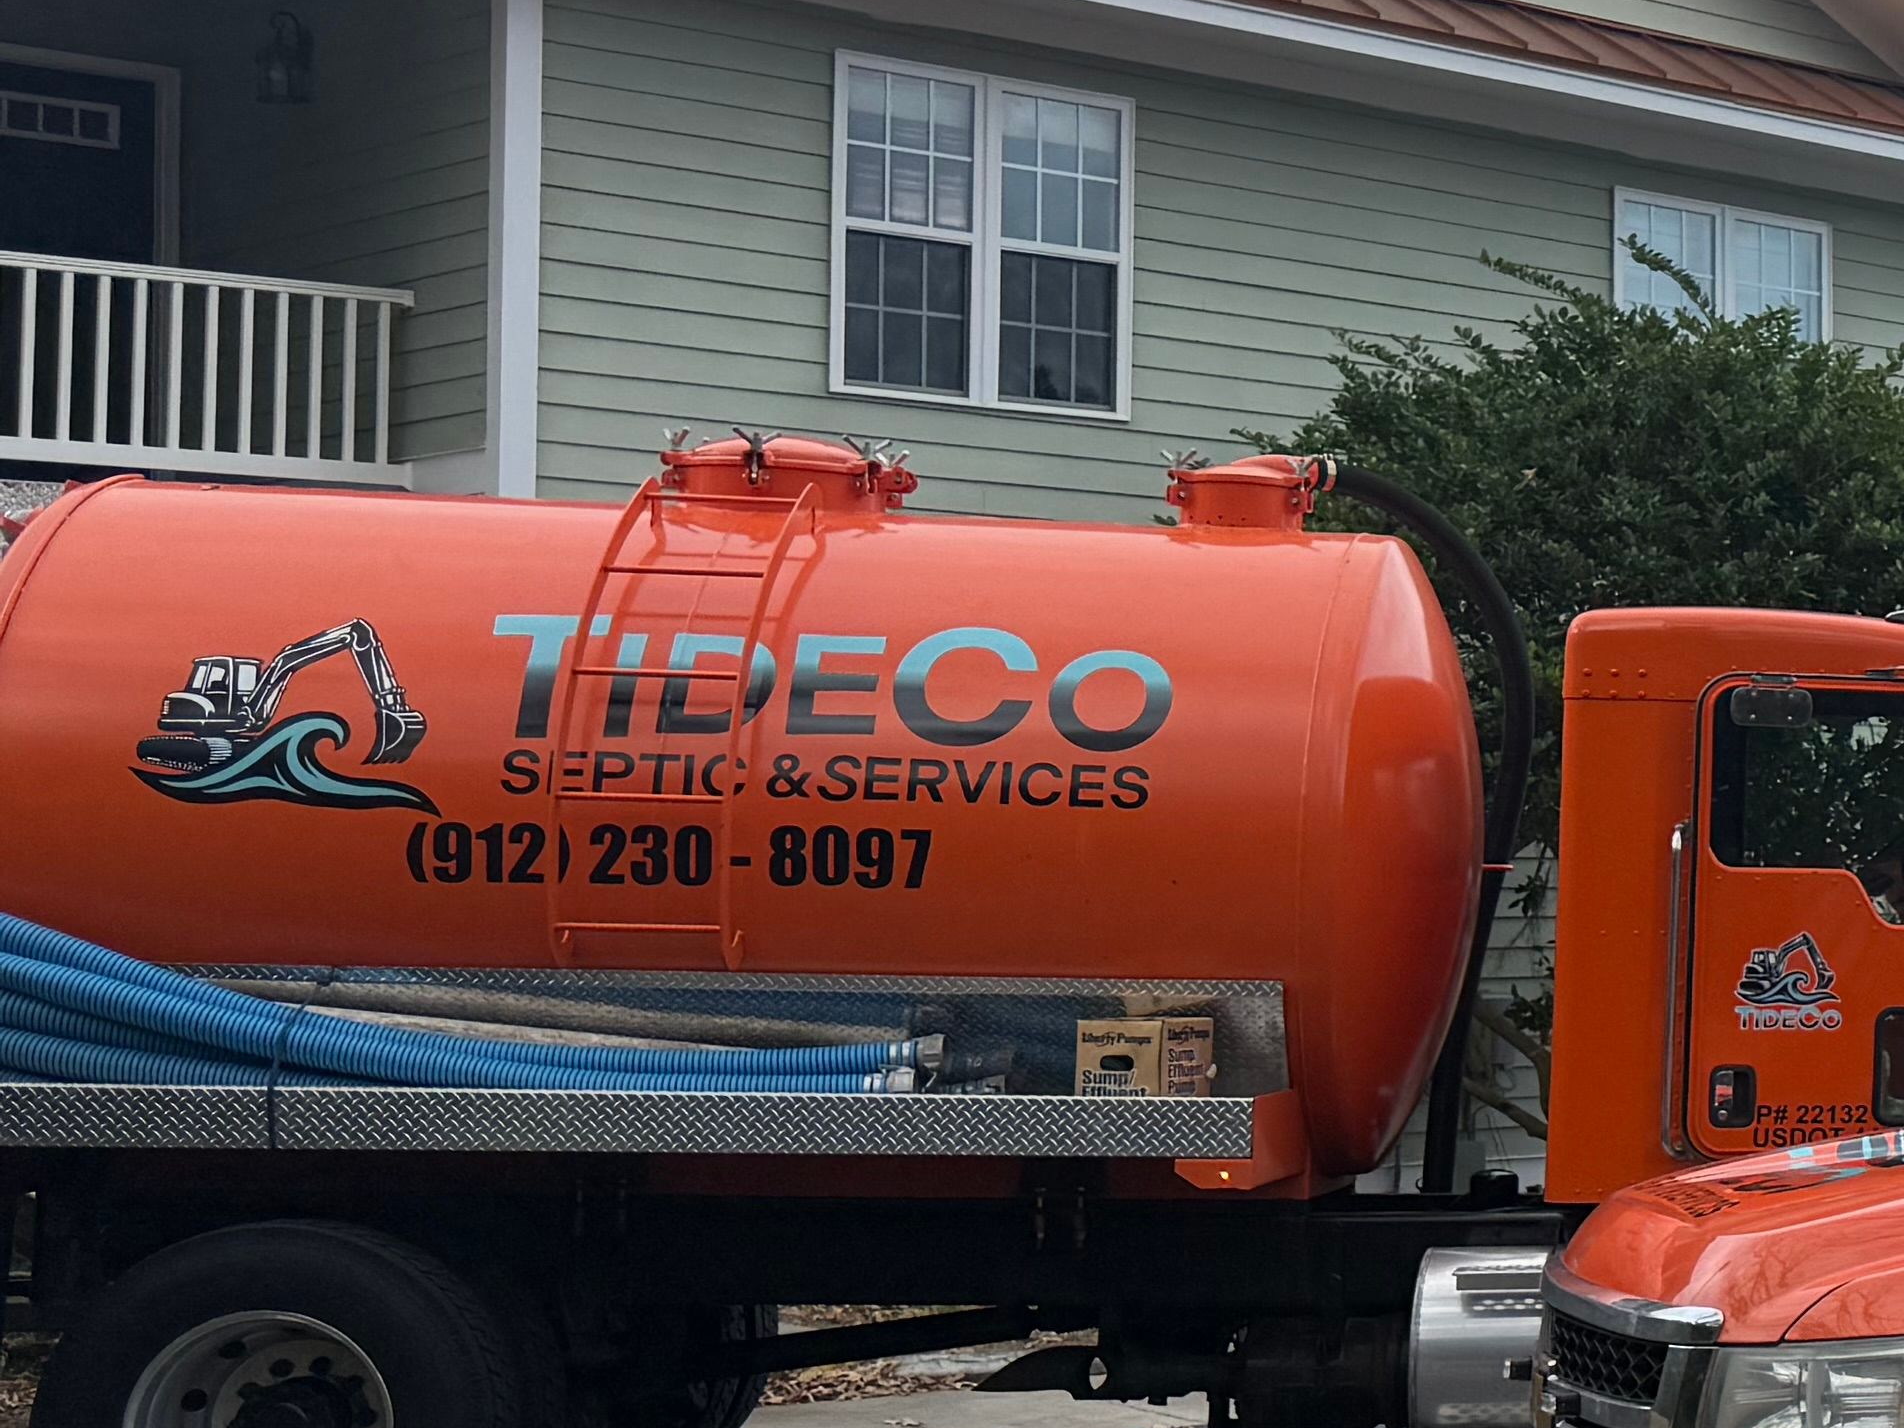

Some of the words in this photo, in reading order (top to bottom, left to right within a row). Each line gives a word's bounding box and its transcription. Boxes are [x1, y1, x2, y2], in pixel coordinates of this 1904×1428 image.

[766, 754, 811, 798] &
[817, 755, 1150, 810] SERVICES
[405, 822, 571, 886] (912)
[589, 824, 713, 887] 230
[768, 825, 932, 890] 8097
[1756, 1104, 1788, 1124] P#
[1796, 1104, 1868, 1124] 22132
